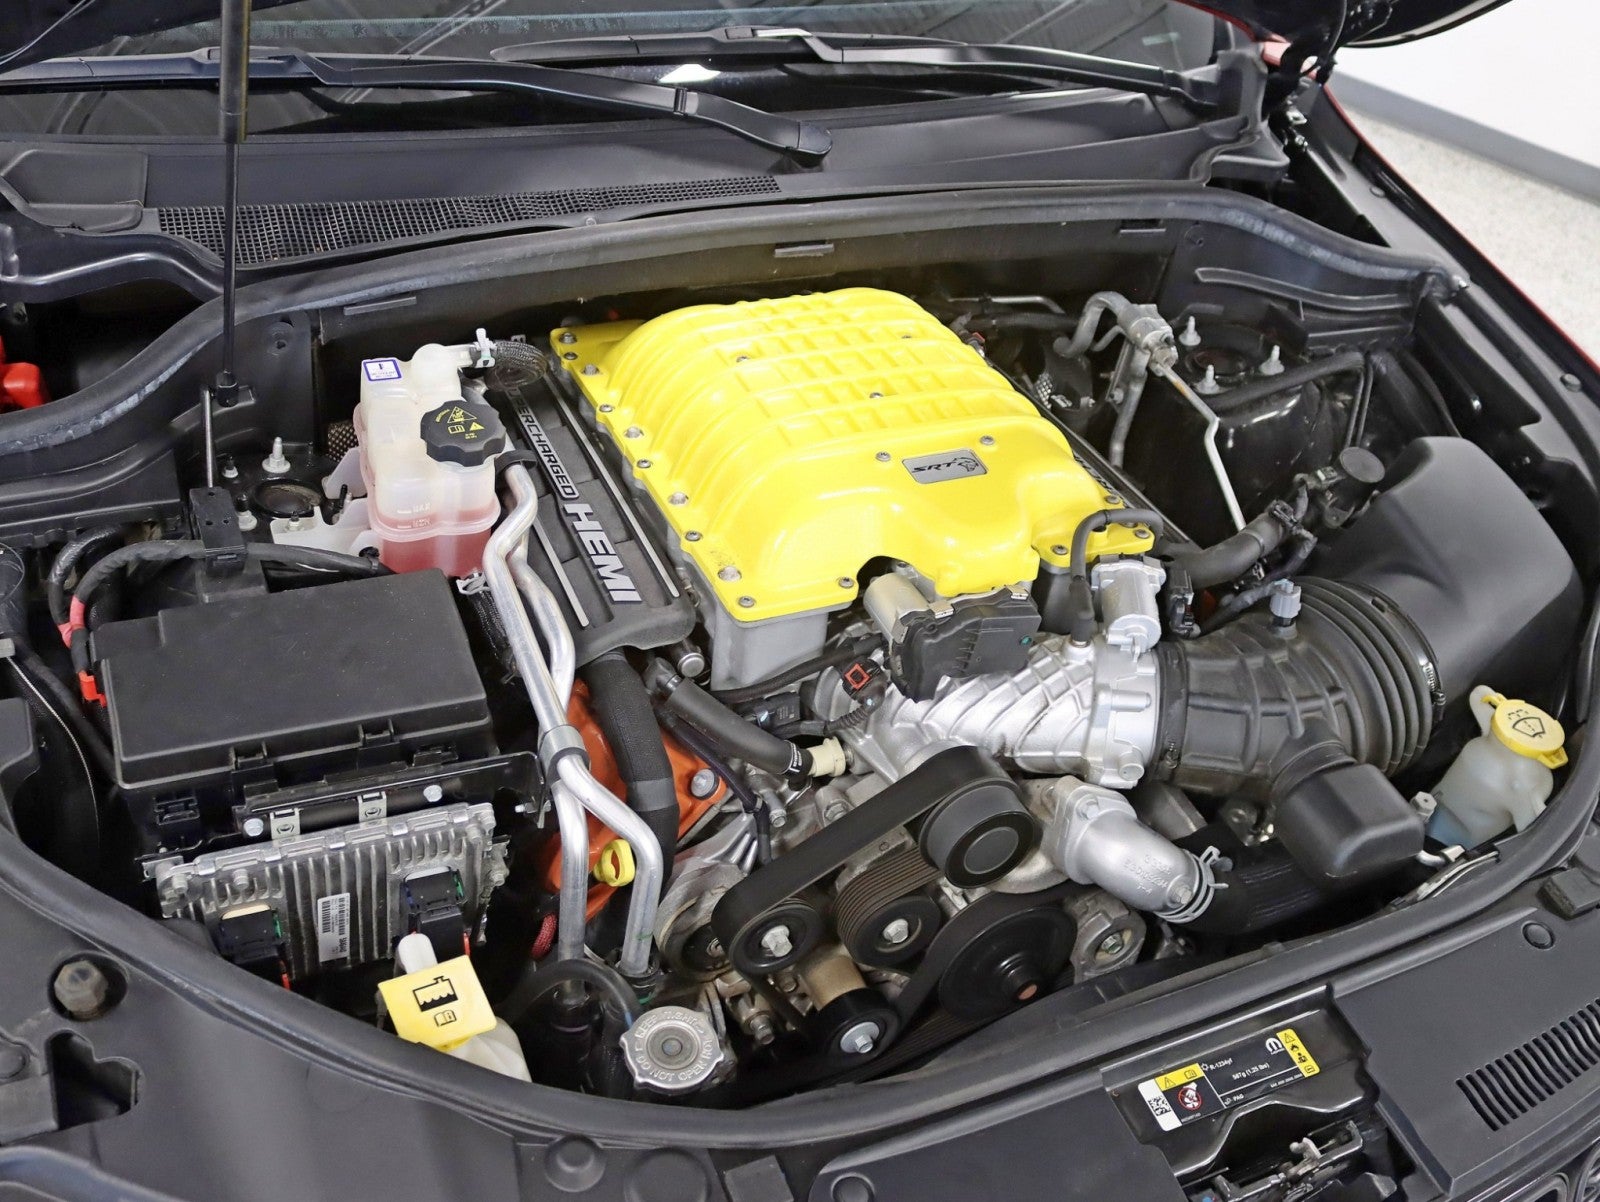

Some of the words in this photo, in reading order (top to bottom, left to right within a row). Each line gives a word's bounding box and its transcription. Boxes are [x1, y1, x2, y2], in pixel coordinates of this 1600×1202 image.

[509, 389, 577, 496] UPERCHARGED
[911, 461, 956, 474] SRT
[563, 503, 642, 602] HEMI
[650, 1070, 675, 1081] NOT
[678, 1060, 707, 1081] OPEN
